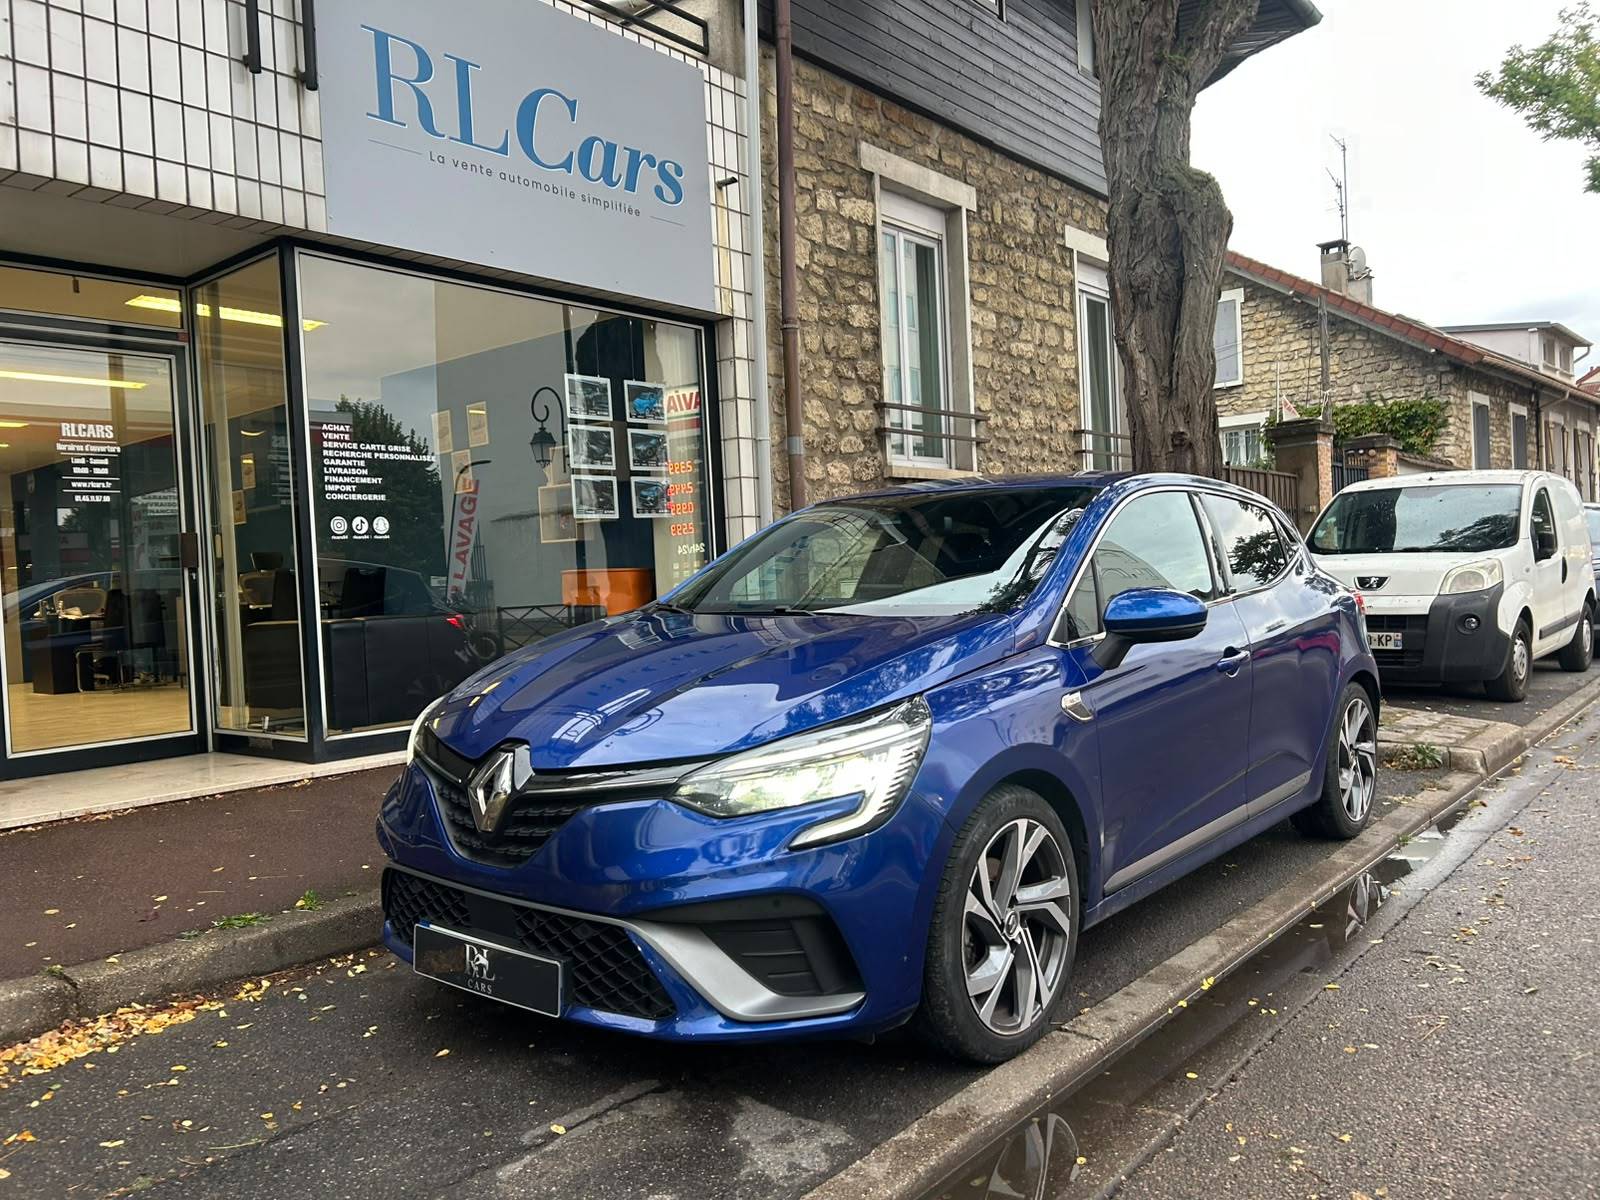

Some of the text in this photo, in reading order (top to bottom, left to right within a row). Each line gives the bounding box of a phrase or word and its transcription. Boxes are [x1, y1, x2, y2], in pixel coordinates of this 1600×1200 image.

[429, 151, 641, 217] La vente automobile simplifiée
[61, 422, 114, 438] RLCARS
[322, 424, 350, 432] ACHAT
[322, 432, 350, 441] VENTE
[322, 441, 411, 453] SERVICE CARTE GRISE
[323, 450, 372, 458] RECHERCHE
[323, 458, 366, 467] GARANTIE
[323, 467, 369, 475] LIVRAISON
[324, 476, 382, 484] FINANCEMENT
[325, 484, 357, 492] IMPORT
[453, 478, 480, 580] LAVAGE
[468, 979, 492, 994] CARS
